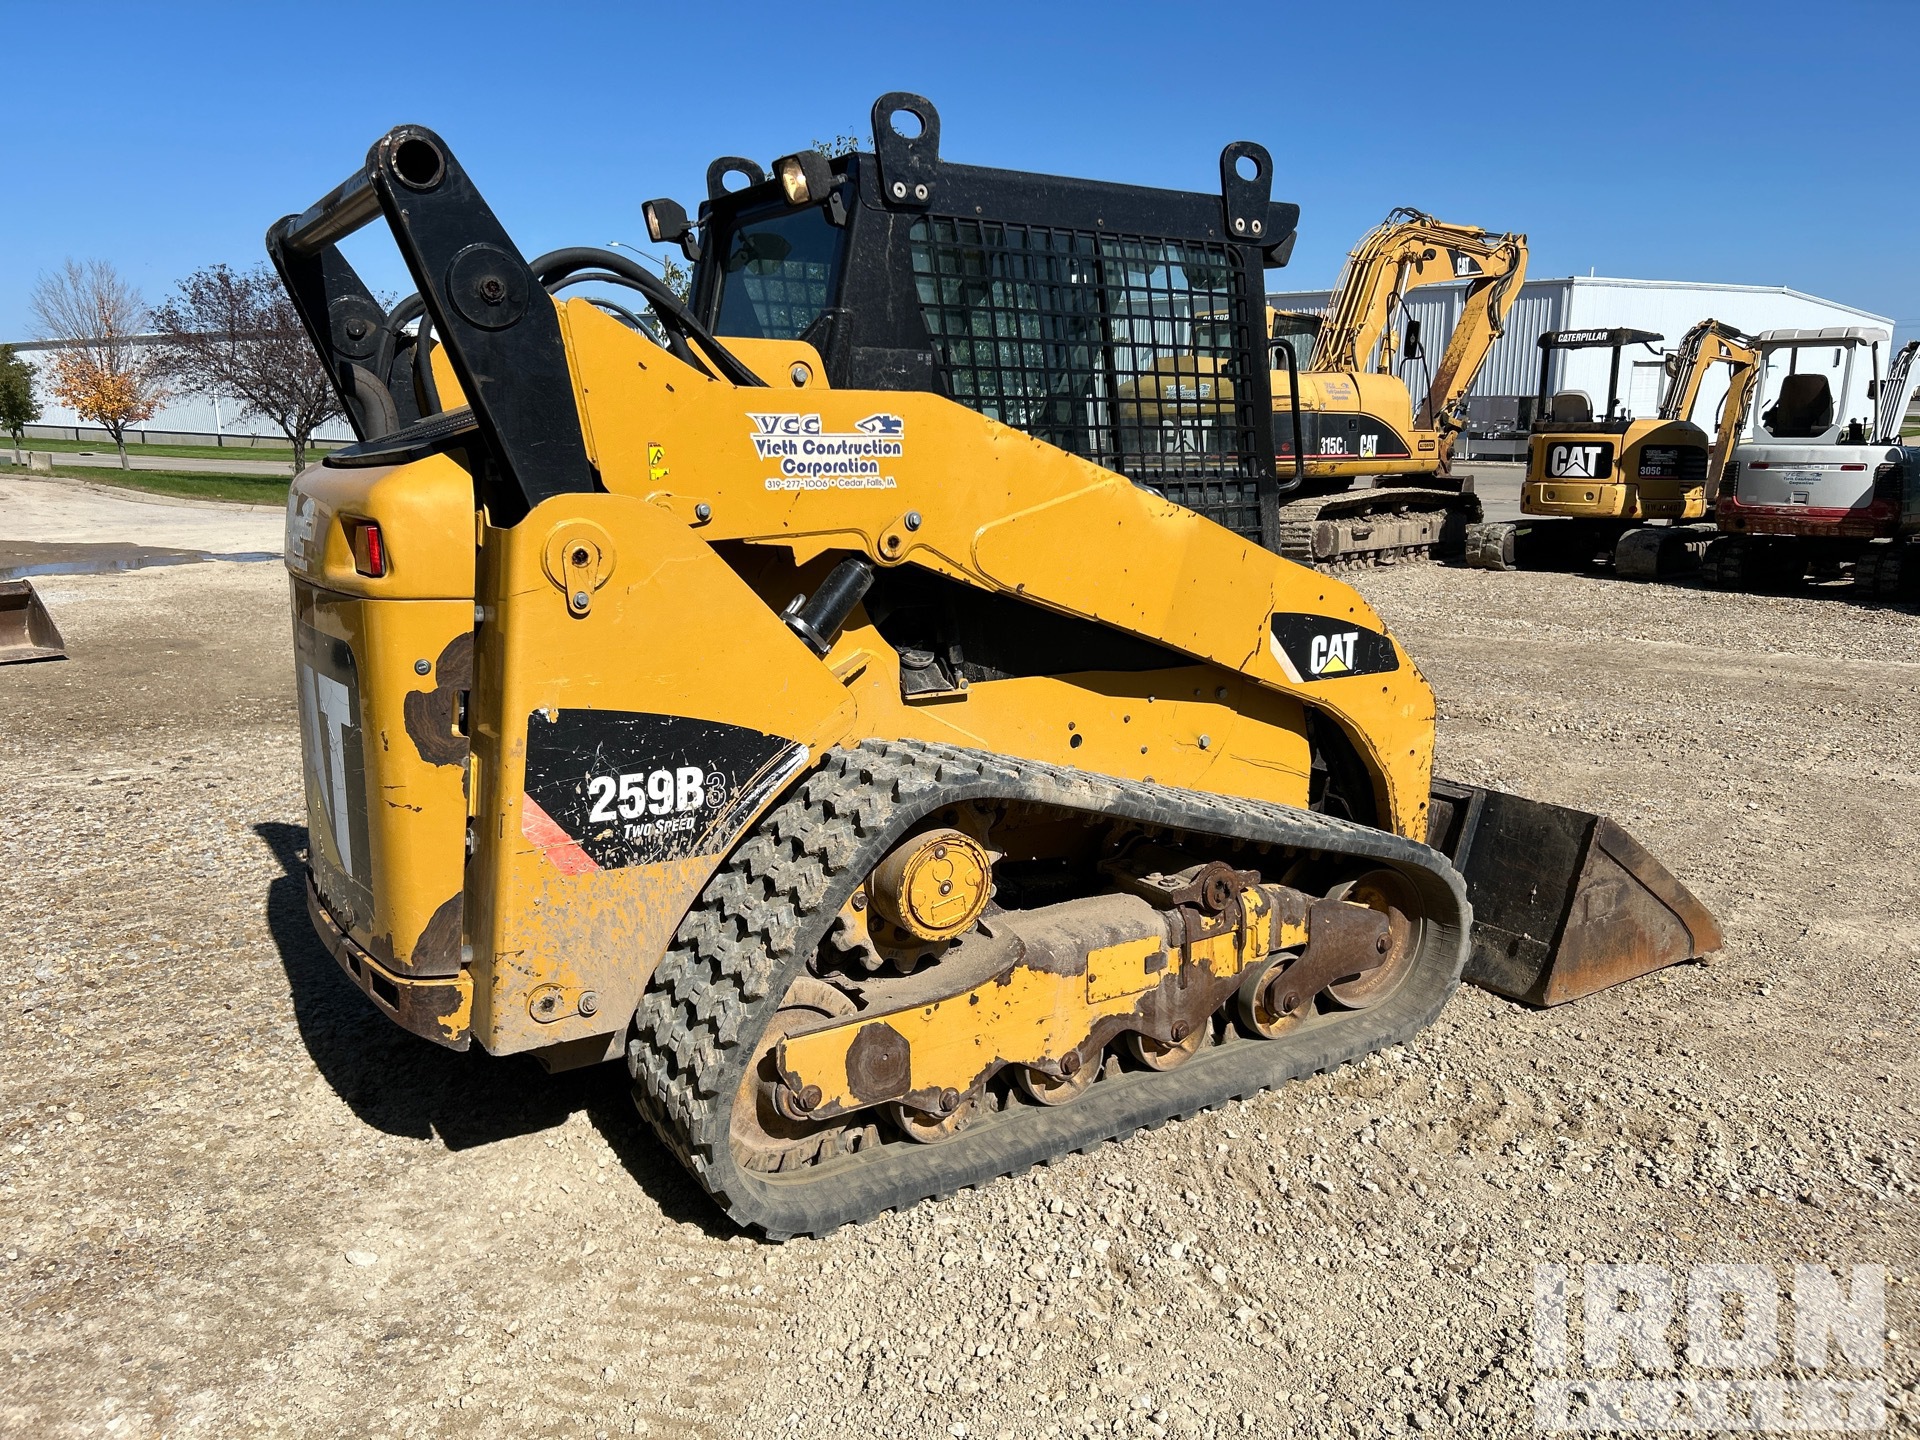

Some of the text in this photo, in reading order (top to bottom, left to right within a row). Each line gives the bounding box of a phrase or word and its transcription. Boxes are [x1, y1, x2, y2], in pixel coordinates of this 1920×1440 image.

[1558, 332, 1608, 342] CATERPILLAR
[753, 415, 820, 435] VCC
[756, 439, 901, 455] Vieth Construction
[1320, 436, 1343, 455] 315C
[1360, 434, 1379, 458] CAT
[783, 458, 878, 477] Corporation
[1551, 445, 1603, 478] CAT
[767, 480, 828, 489] 319-277-1006
[1310, 632, 1359, 675] CAT
